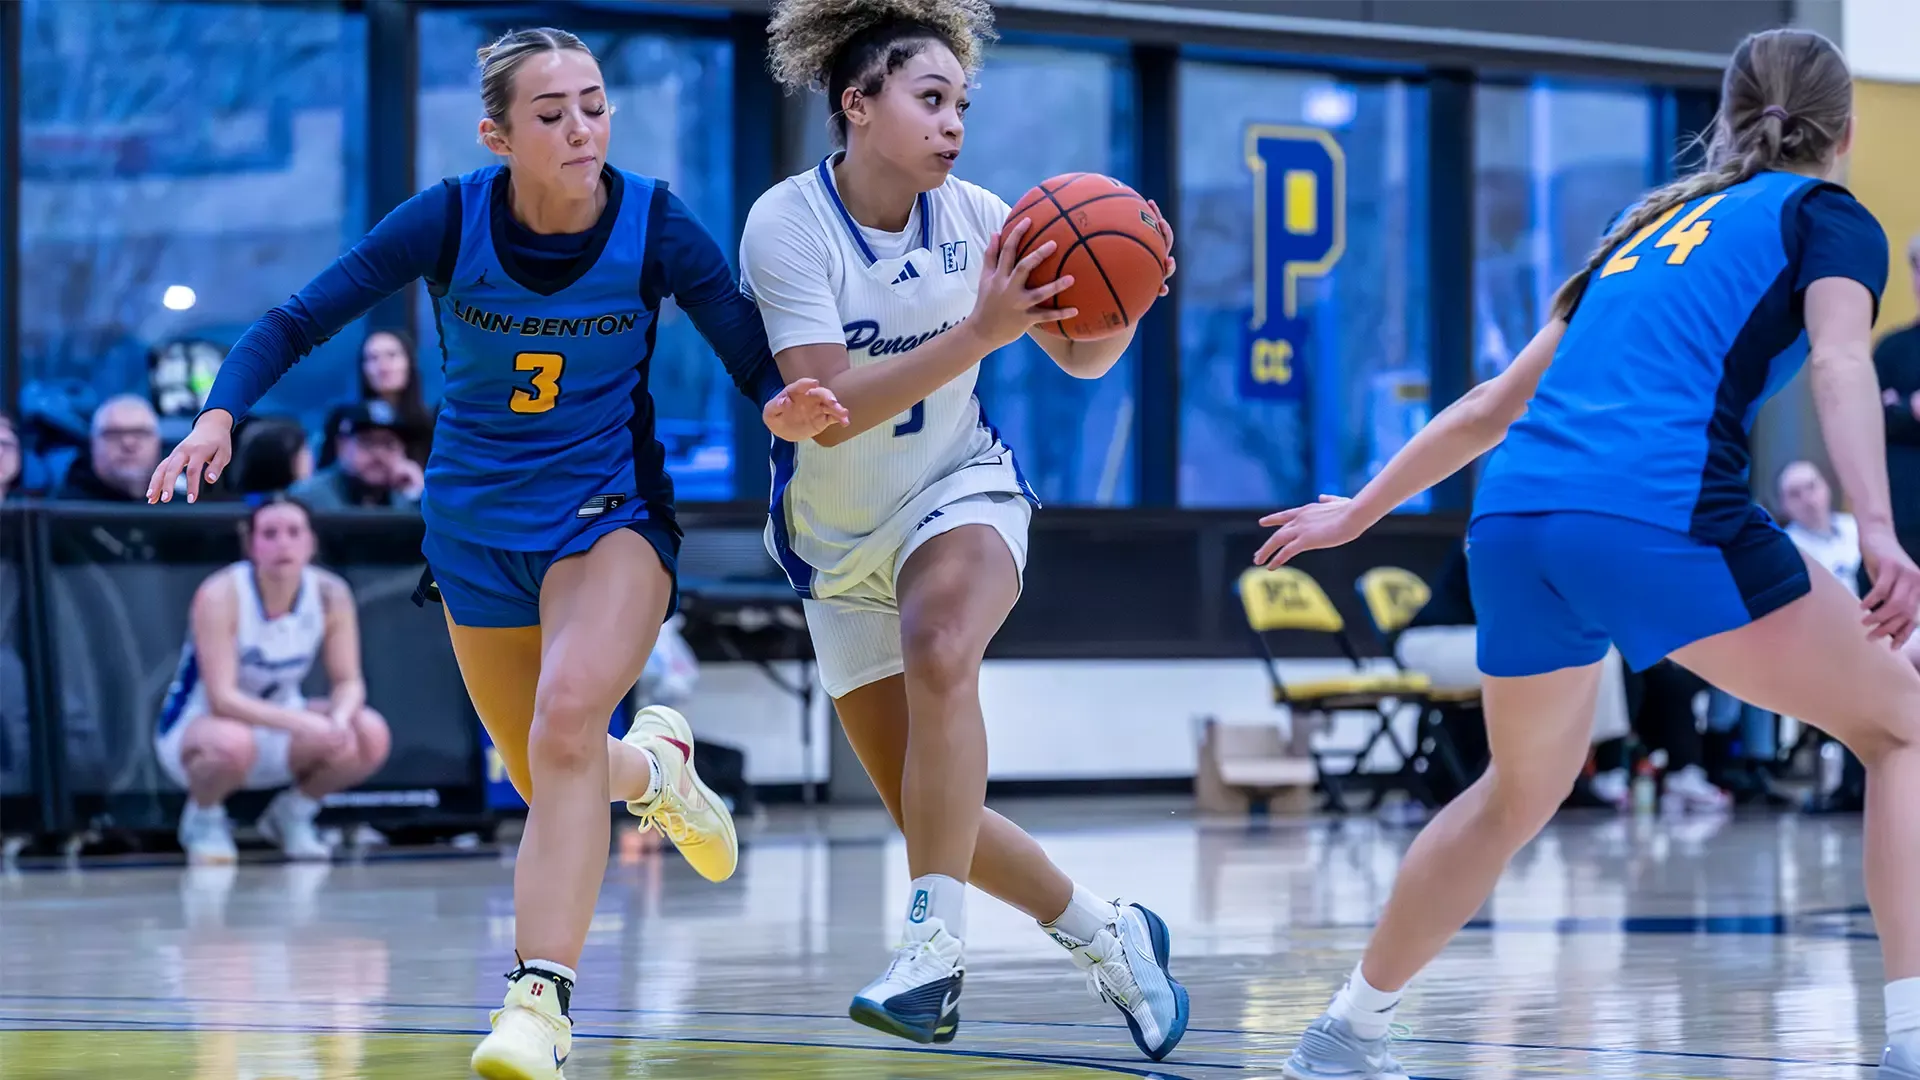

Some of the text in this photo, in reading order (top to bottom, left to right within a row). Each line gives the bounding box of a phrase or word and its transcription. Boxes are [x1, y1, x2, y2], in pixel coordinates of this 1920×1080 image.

[1245, 124, 1346, 330] P
[1599, 193, 1728, 279] 24
[453, 299, 638, 338] LINN-BENTON
[510, 350, 567, 415] 3
[610, 500, 618, 509] S
